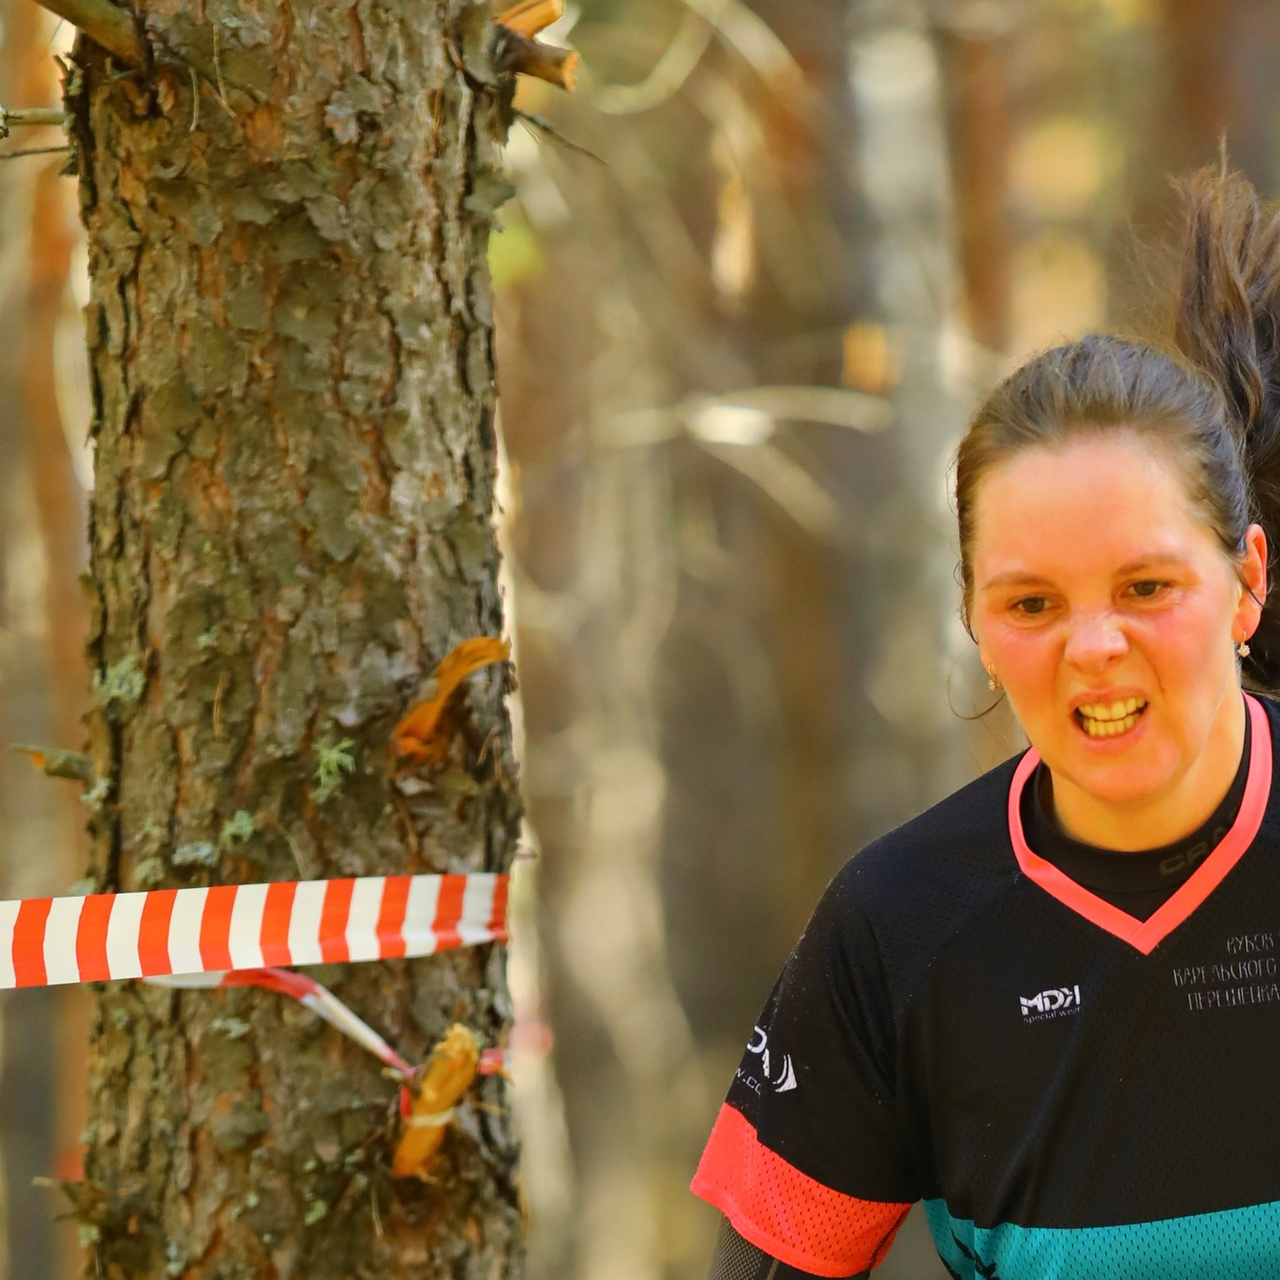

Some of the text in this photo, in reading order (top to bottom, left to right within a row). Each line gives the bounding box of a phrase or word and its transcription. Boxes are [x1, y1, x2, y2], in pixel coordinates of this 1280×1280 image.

[1226, 932, 1275, 955] КУБОК
[1172, 957, 1277, 987] КАРЕЛЬСКОГО
[1187, 983, 1280, 1011] ПЕРЕШЕЙКА
[1023, 1006, 1080, 1024] special wear
